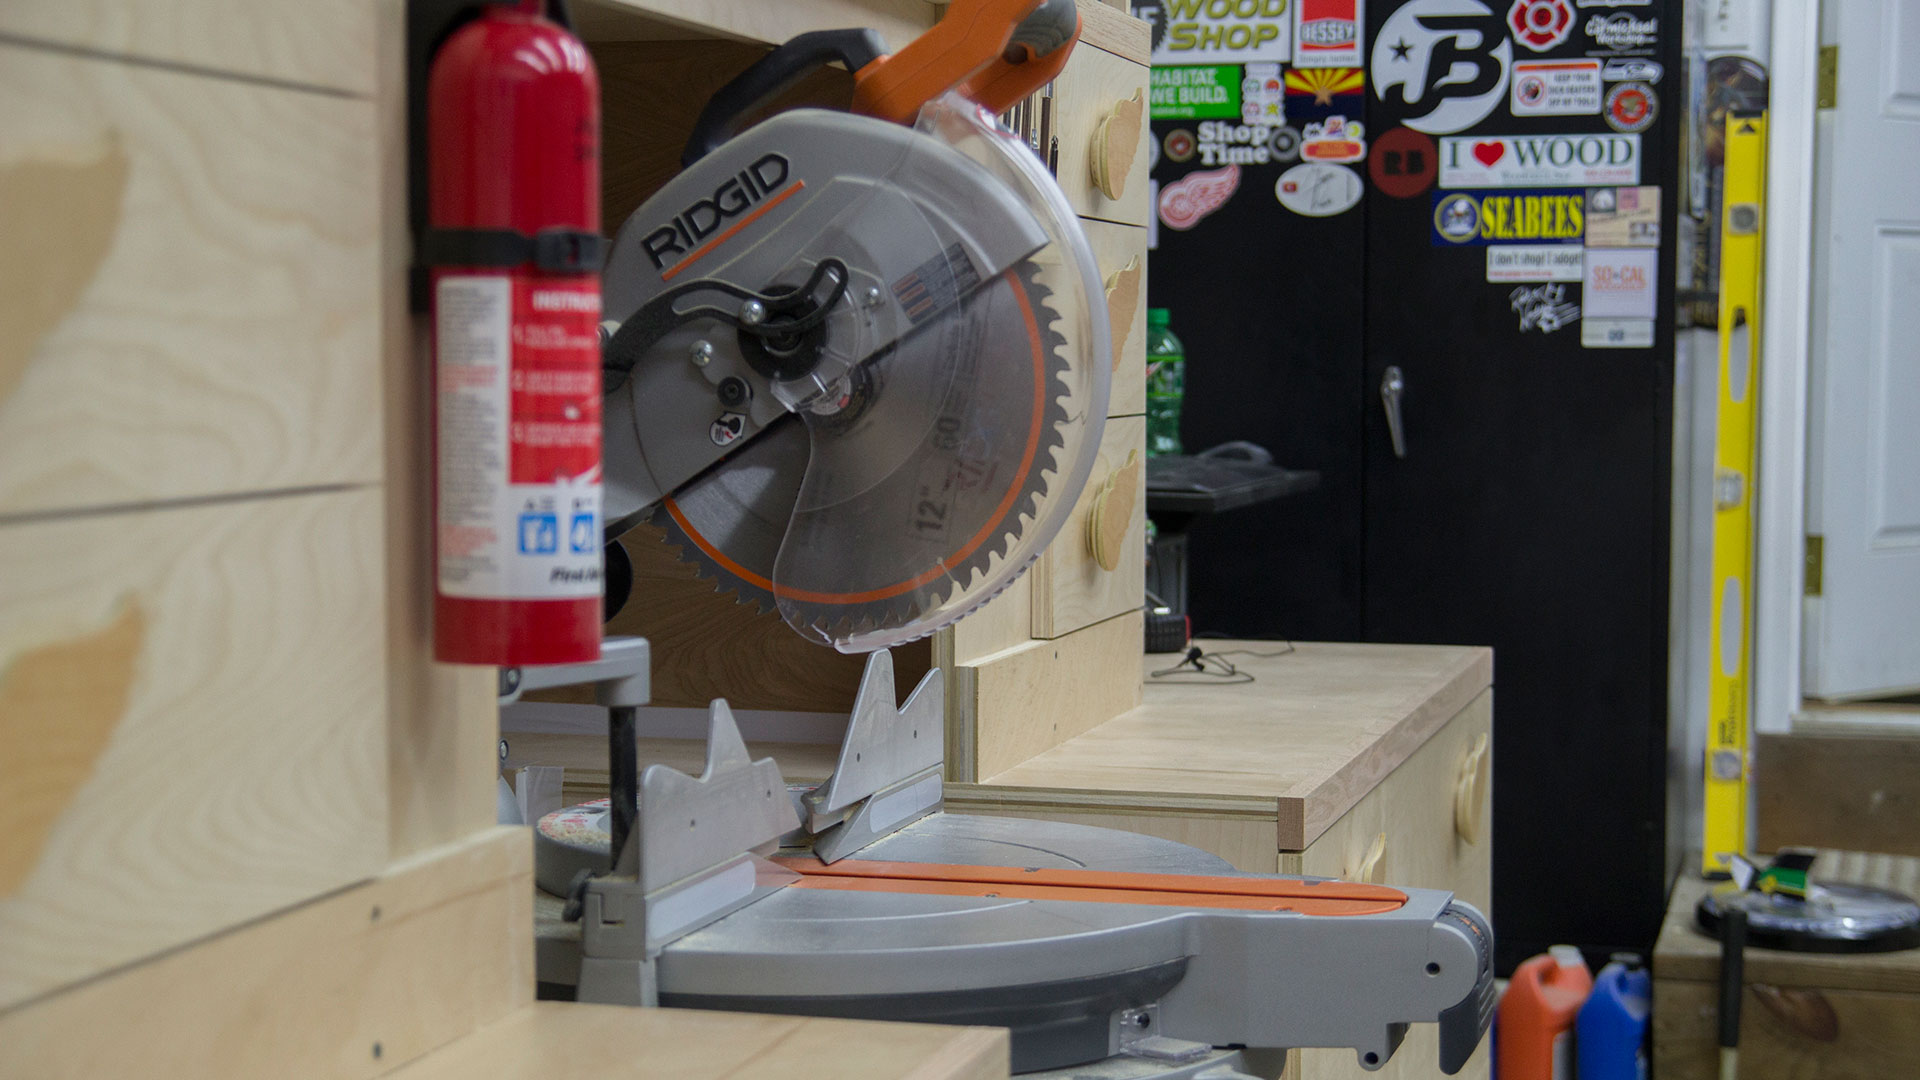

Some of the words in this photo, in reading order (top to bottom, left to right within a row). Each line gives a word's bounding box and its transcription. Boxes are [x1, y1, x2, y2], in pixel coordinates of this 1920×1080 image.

[1167, 0, 1286, 19] WOOD
[1167, 23, 1280, 50] SHOP
[1301, 21, 1355, 42] BESSEY
[1197, 121, 1271, 146] Shop
[1197, 142, 1271, 165] Time
[1448, 142, 1459, 168] I
[1513, 138, 1633, 168] WOOD
[641, 152, 790, 270] RIDGID
[1481, 196, 1584, 239] SEABEES
